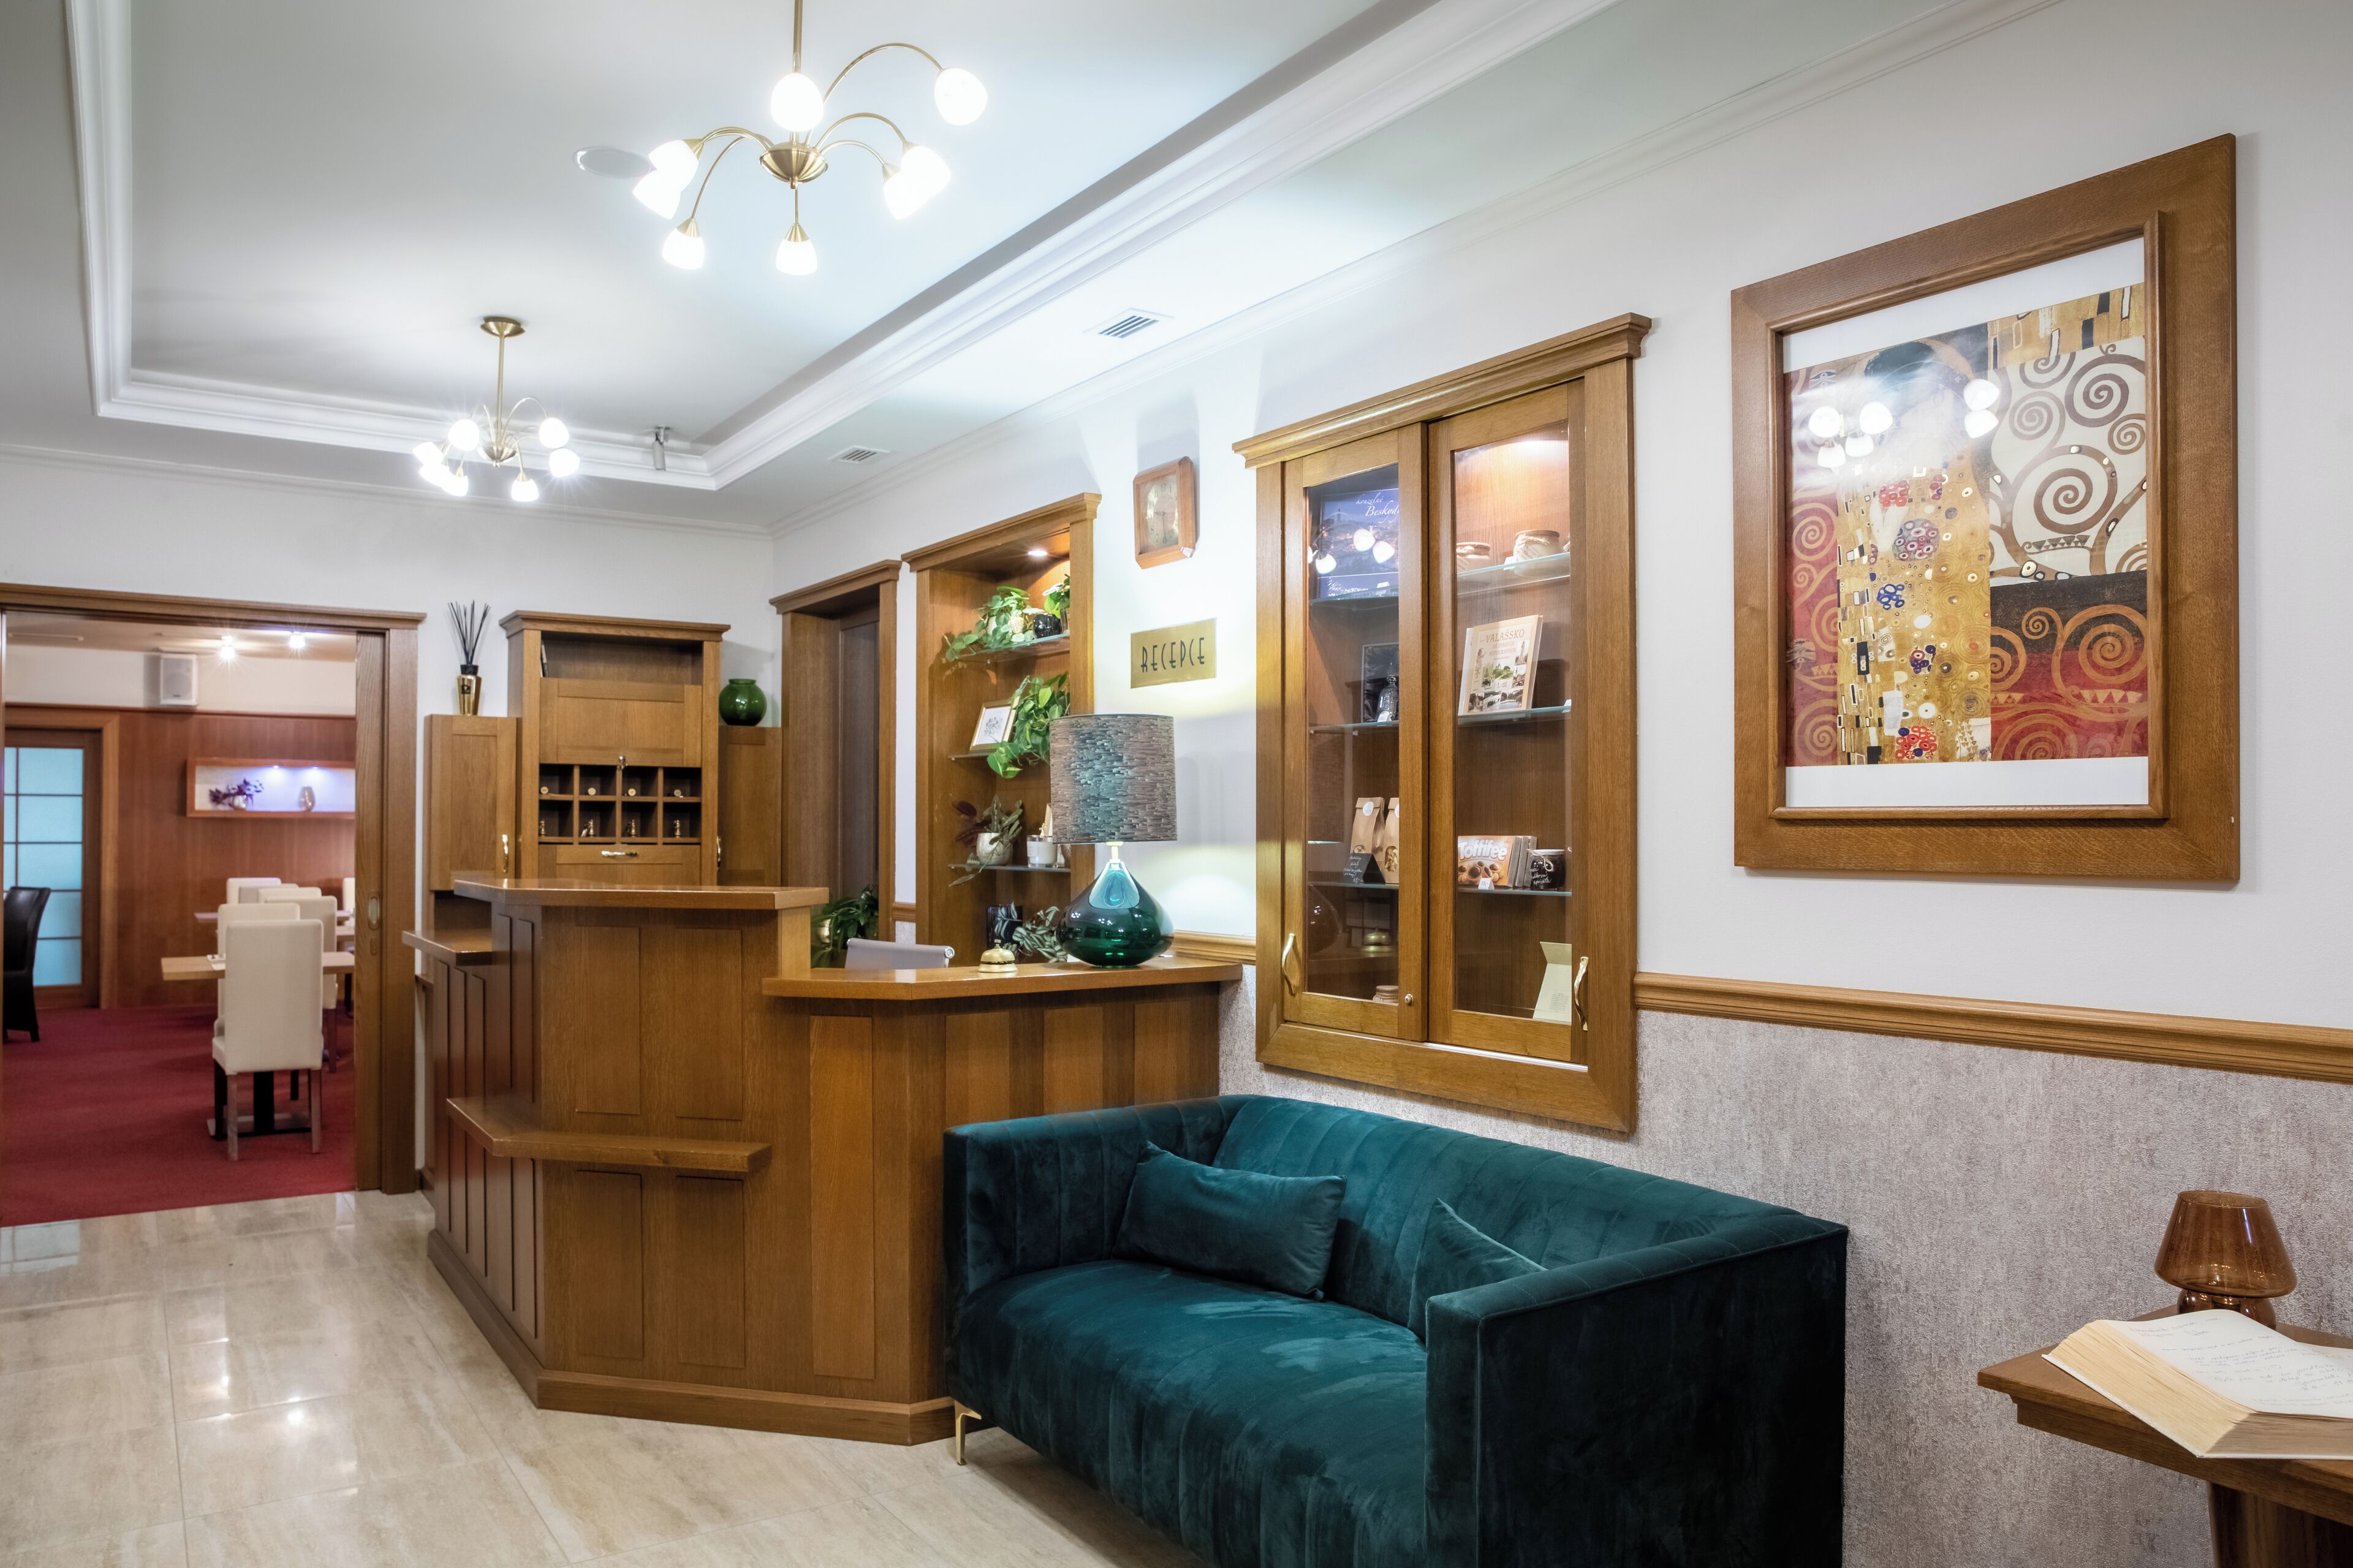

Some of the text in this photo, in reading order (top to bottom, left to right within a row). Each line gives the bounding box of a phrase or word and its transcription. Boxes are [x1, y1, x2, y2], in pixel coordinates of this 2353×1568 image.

[1486, 628, 1525, 643] VALAŠSKO
[1140, 637, 1205, 673] RECEPCE
[1458, 839, 1507, 861] Toffifee
